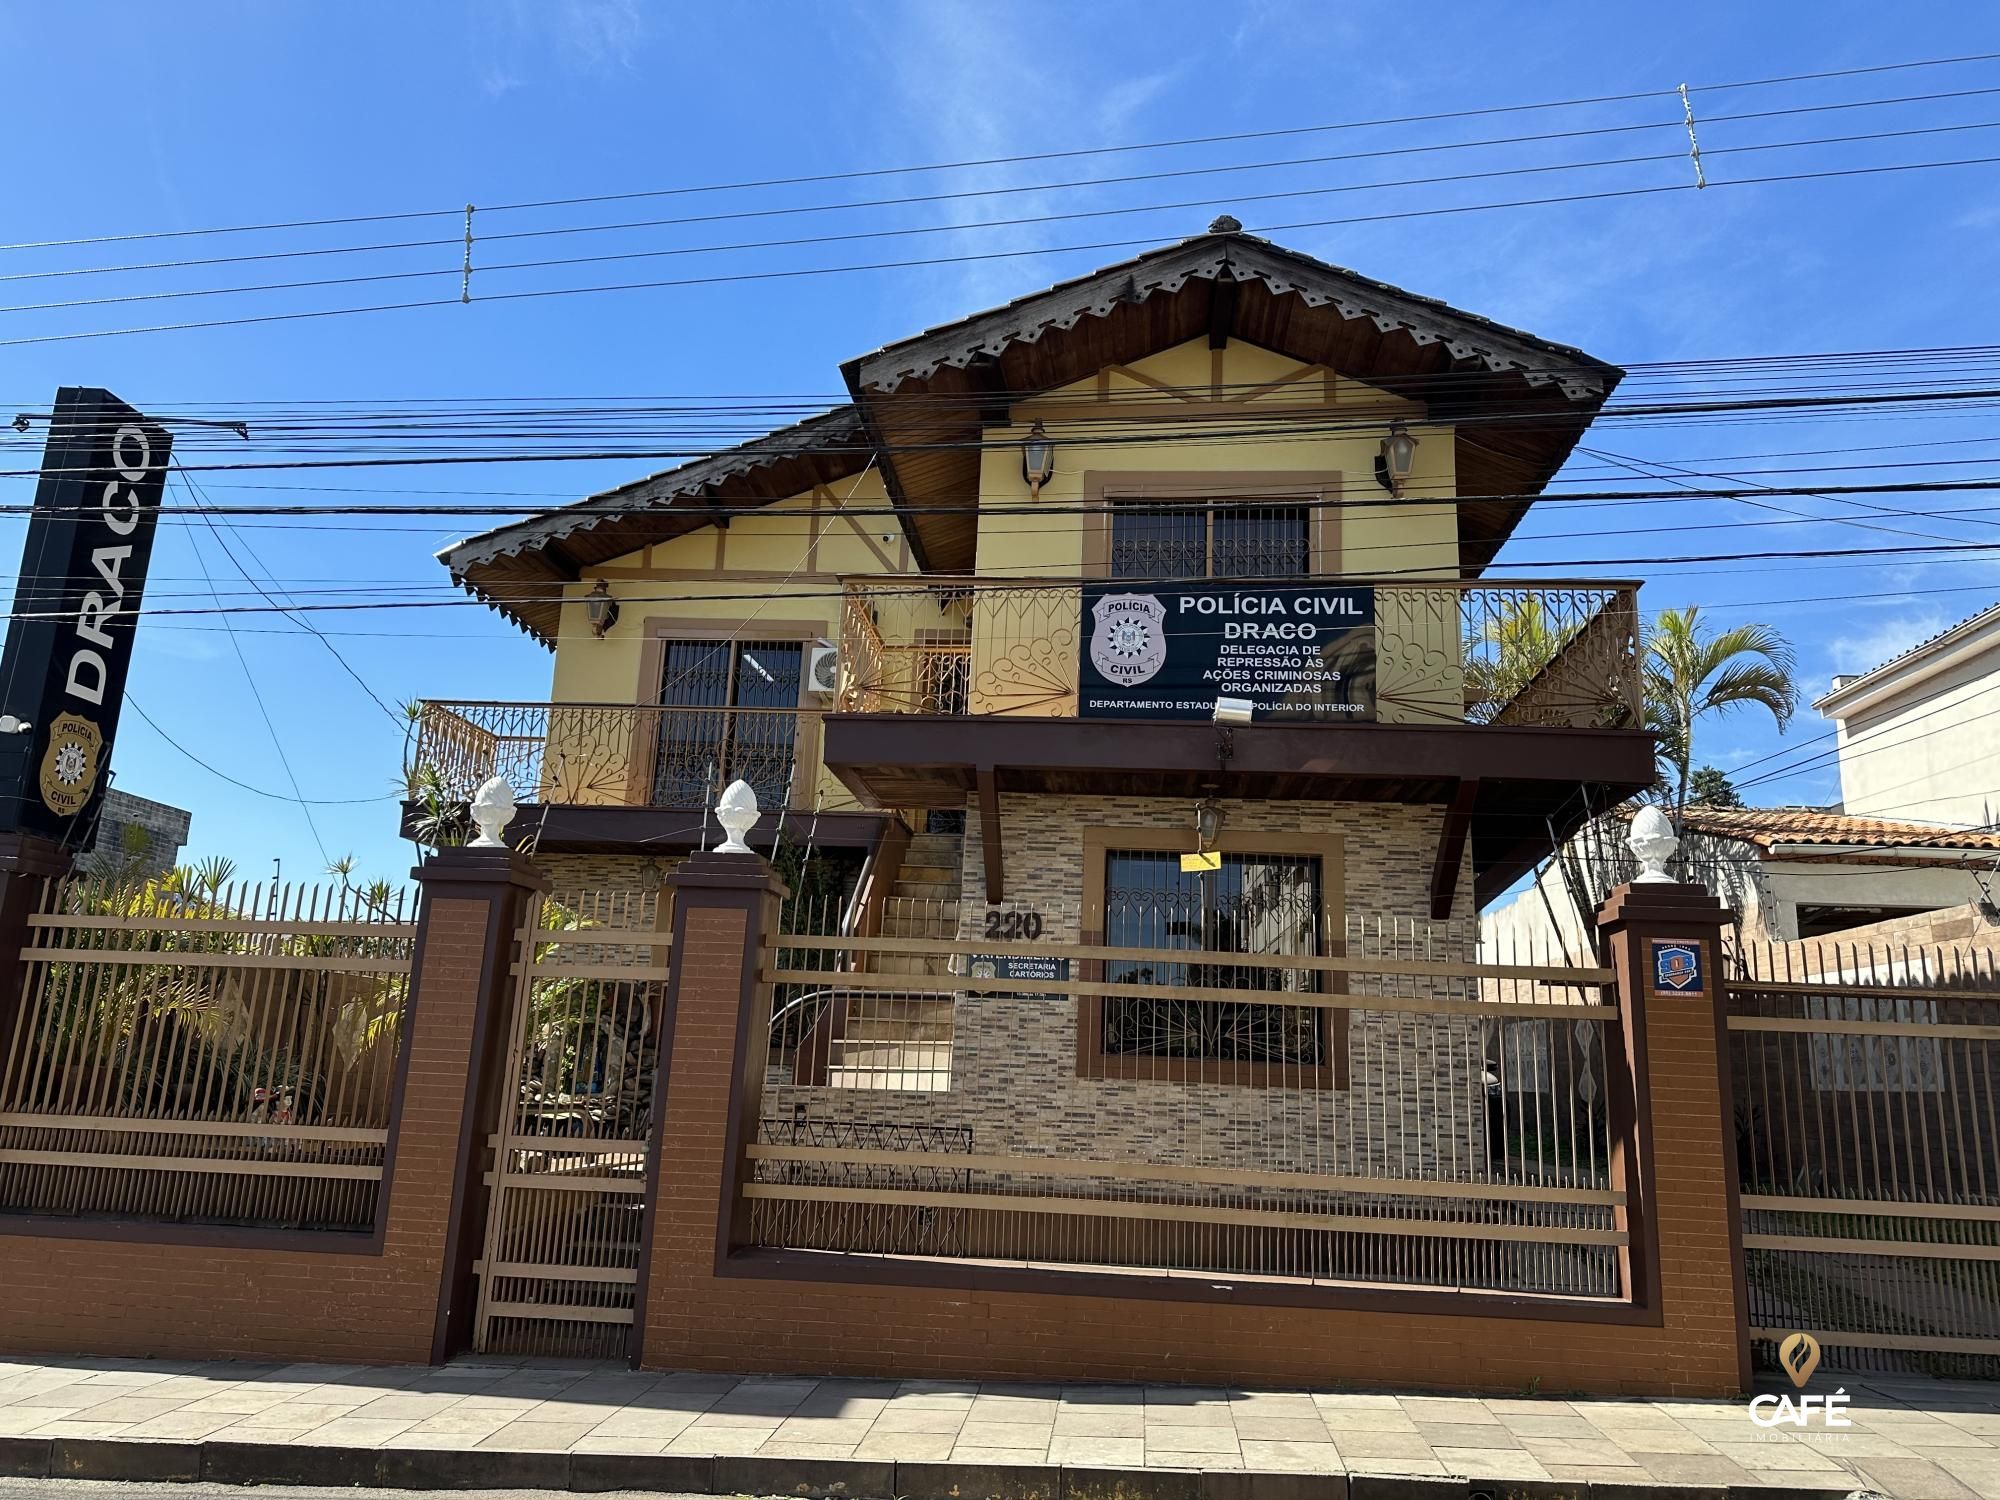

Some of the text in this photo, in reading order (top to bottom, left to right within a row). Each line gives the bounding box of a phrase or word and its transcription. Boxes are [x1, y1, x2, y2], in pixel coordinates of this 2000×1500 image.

[65, 425, 151, 706] DRACO
[1108, 600, 1151, 613] POLÍCIA
[1179, 593, 1364, 615] POLÍCIA CIVIL
[1224, 622, 1317, 640] DRACO
[1220, 645, 1321, 655] DELEGACIA DE
[1217, 656, 1324, 668] REPRESSÃO ÀS
[1110, 664, 1145, 675] CIVIL
[1203, 669, 1341, 681] AÇÕES CRIMINOSAS
[1221, 683, 1322, 693] ORGANIZADAS
[1089, 700, 1173, 710] DEPARTAMENTO
[1251, 701, 1294, 711] POLÍCIA
[1296, 703, 1312, 711] DO
[1314, 703, 1365, 712] INTERIOR
[51, 790, 76, 805] CIVIL
[985, 911, 1042, 940] 220
[1008, 963, 1056, 971] SECRETARIA
[1009, 970, 1055, 979] CARTÓRIOS
